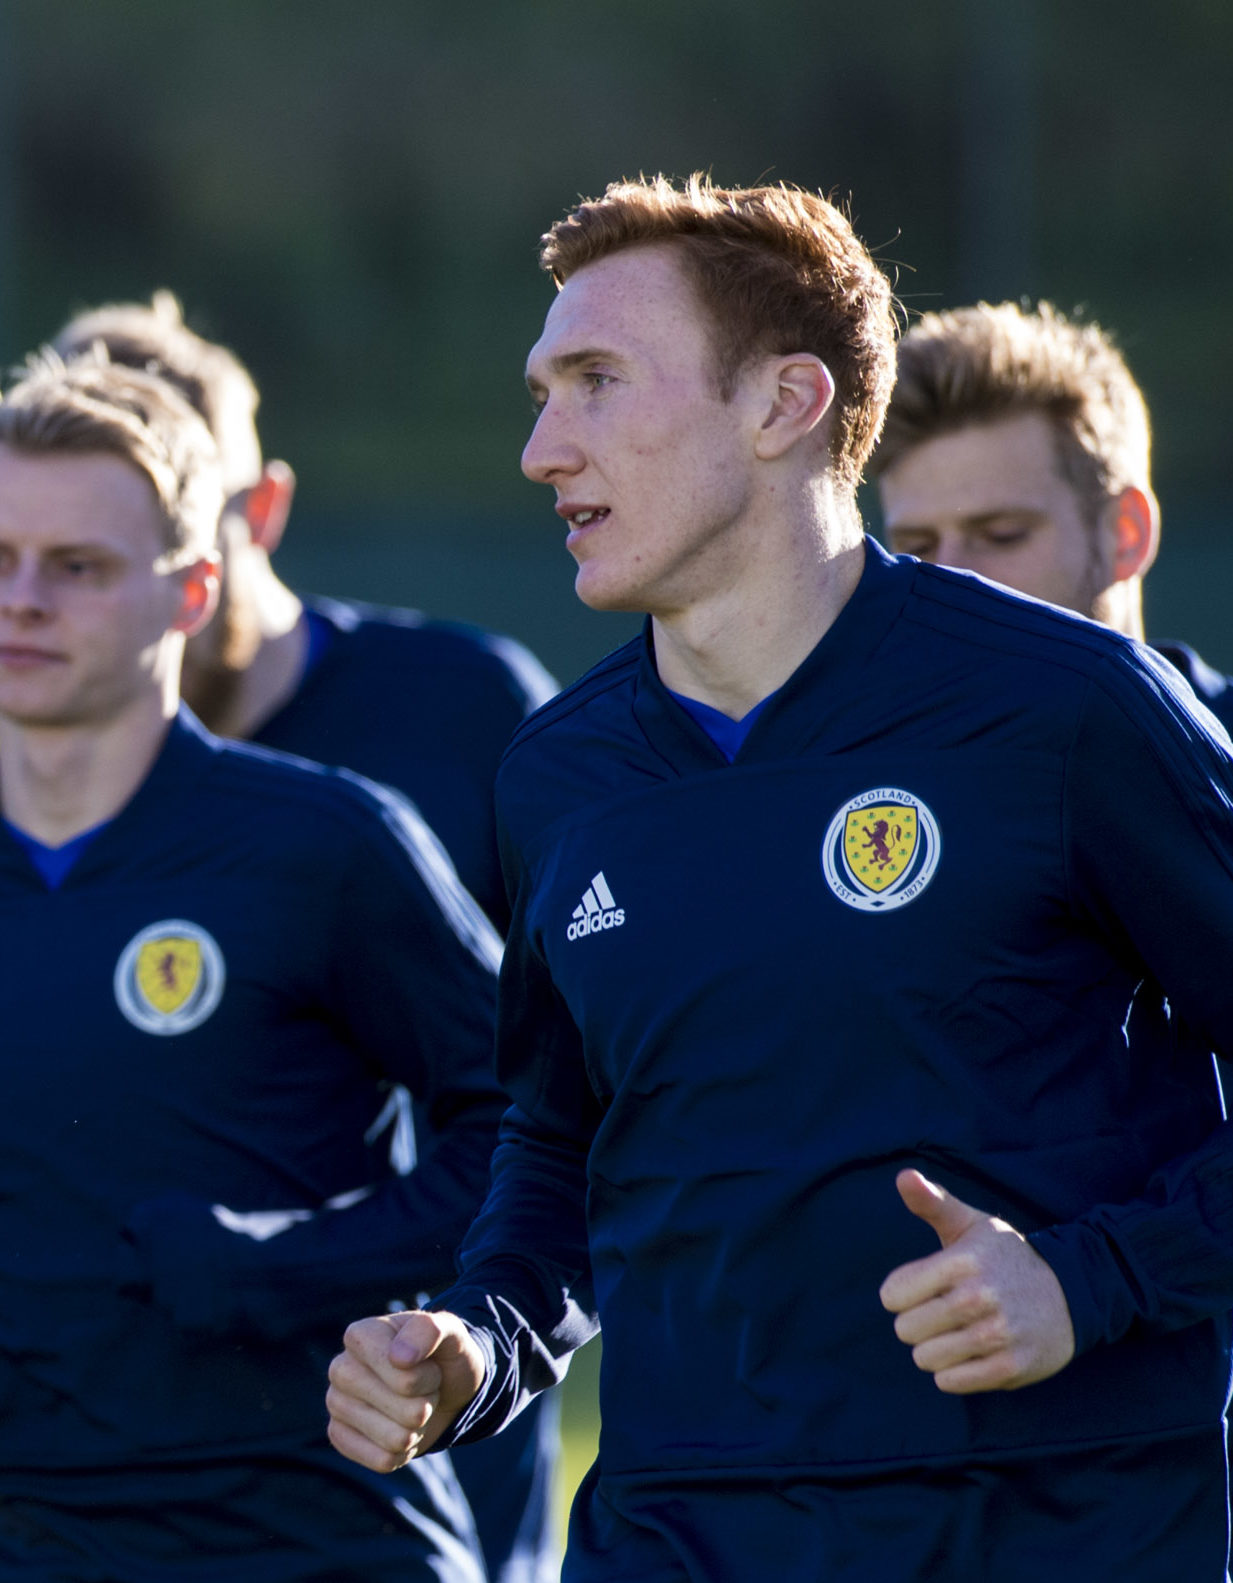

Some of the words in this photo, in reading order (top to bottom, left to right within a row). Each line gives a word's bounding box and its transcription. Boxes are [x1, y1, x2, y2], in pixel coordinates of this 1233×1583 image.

[854, 790, 912, 808] SCOTLAND
[836, 885, 852, 900] EST
[904, 880, 924, 898] 1873
[566, 908, 626, 942] adidas
